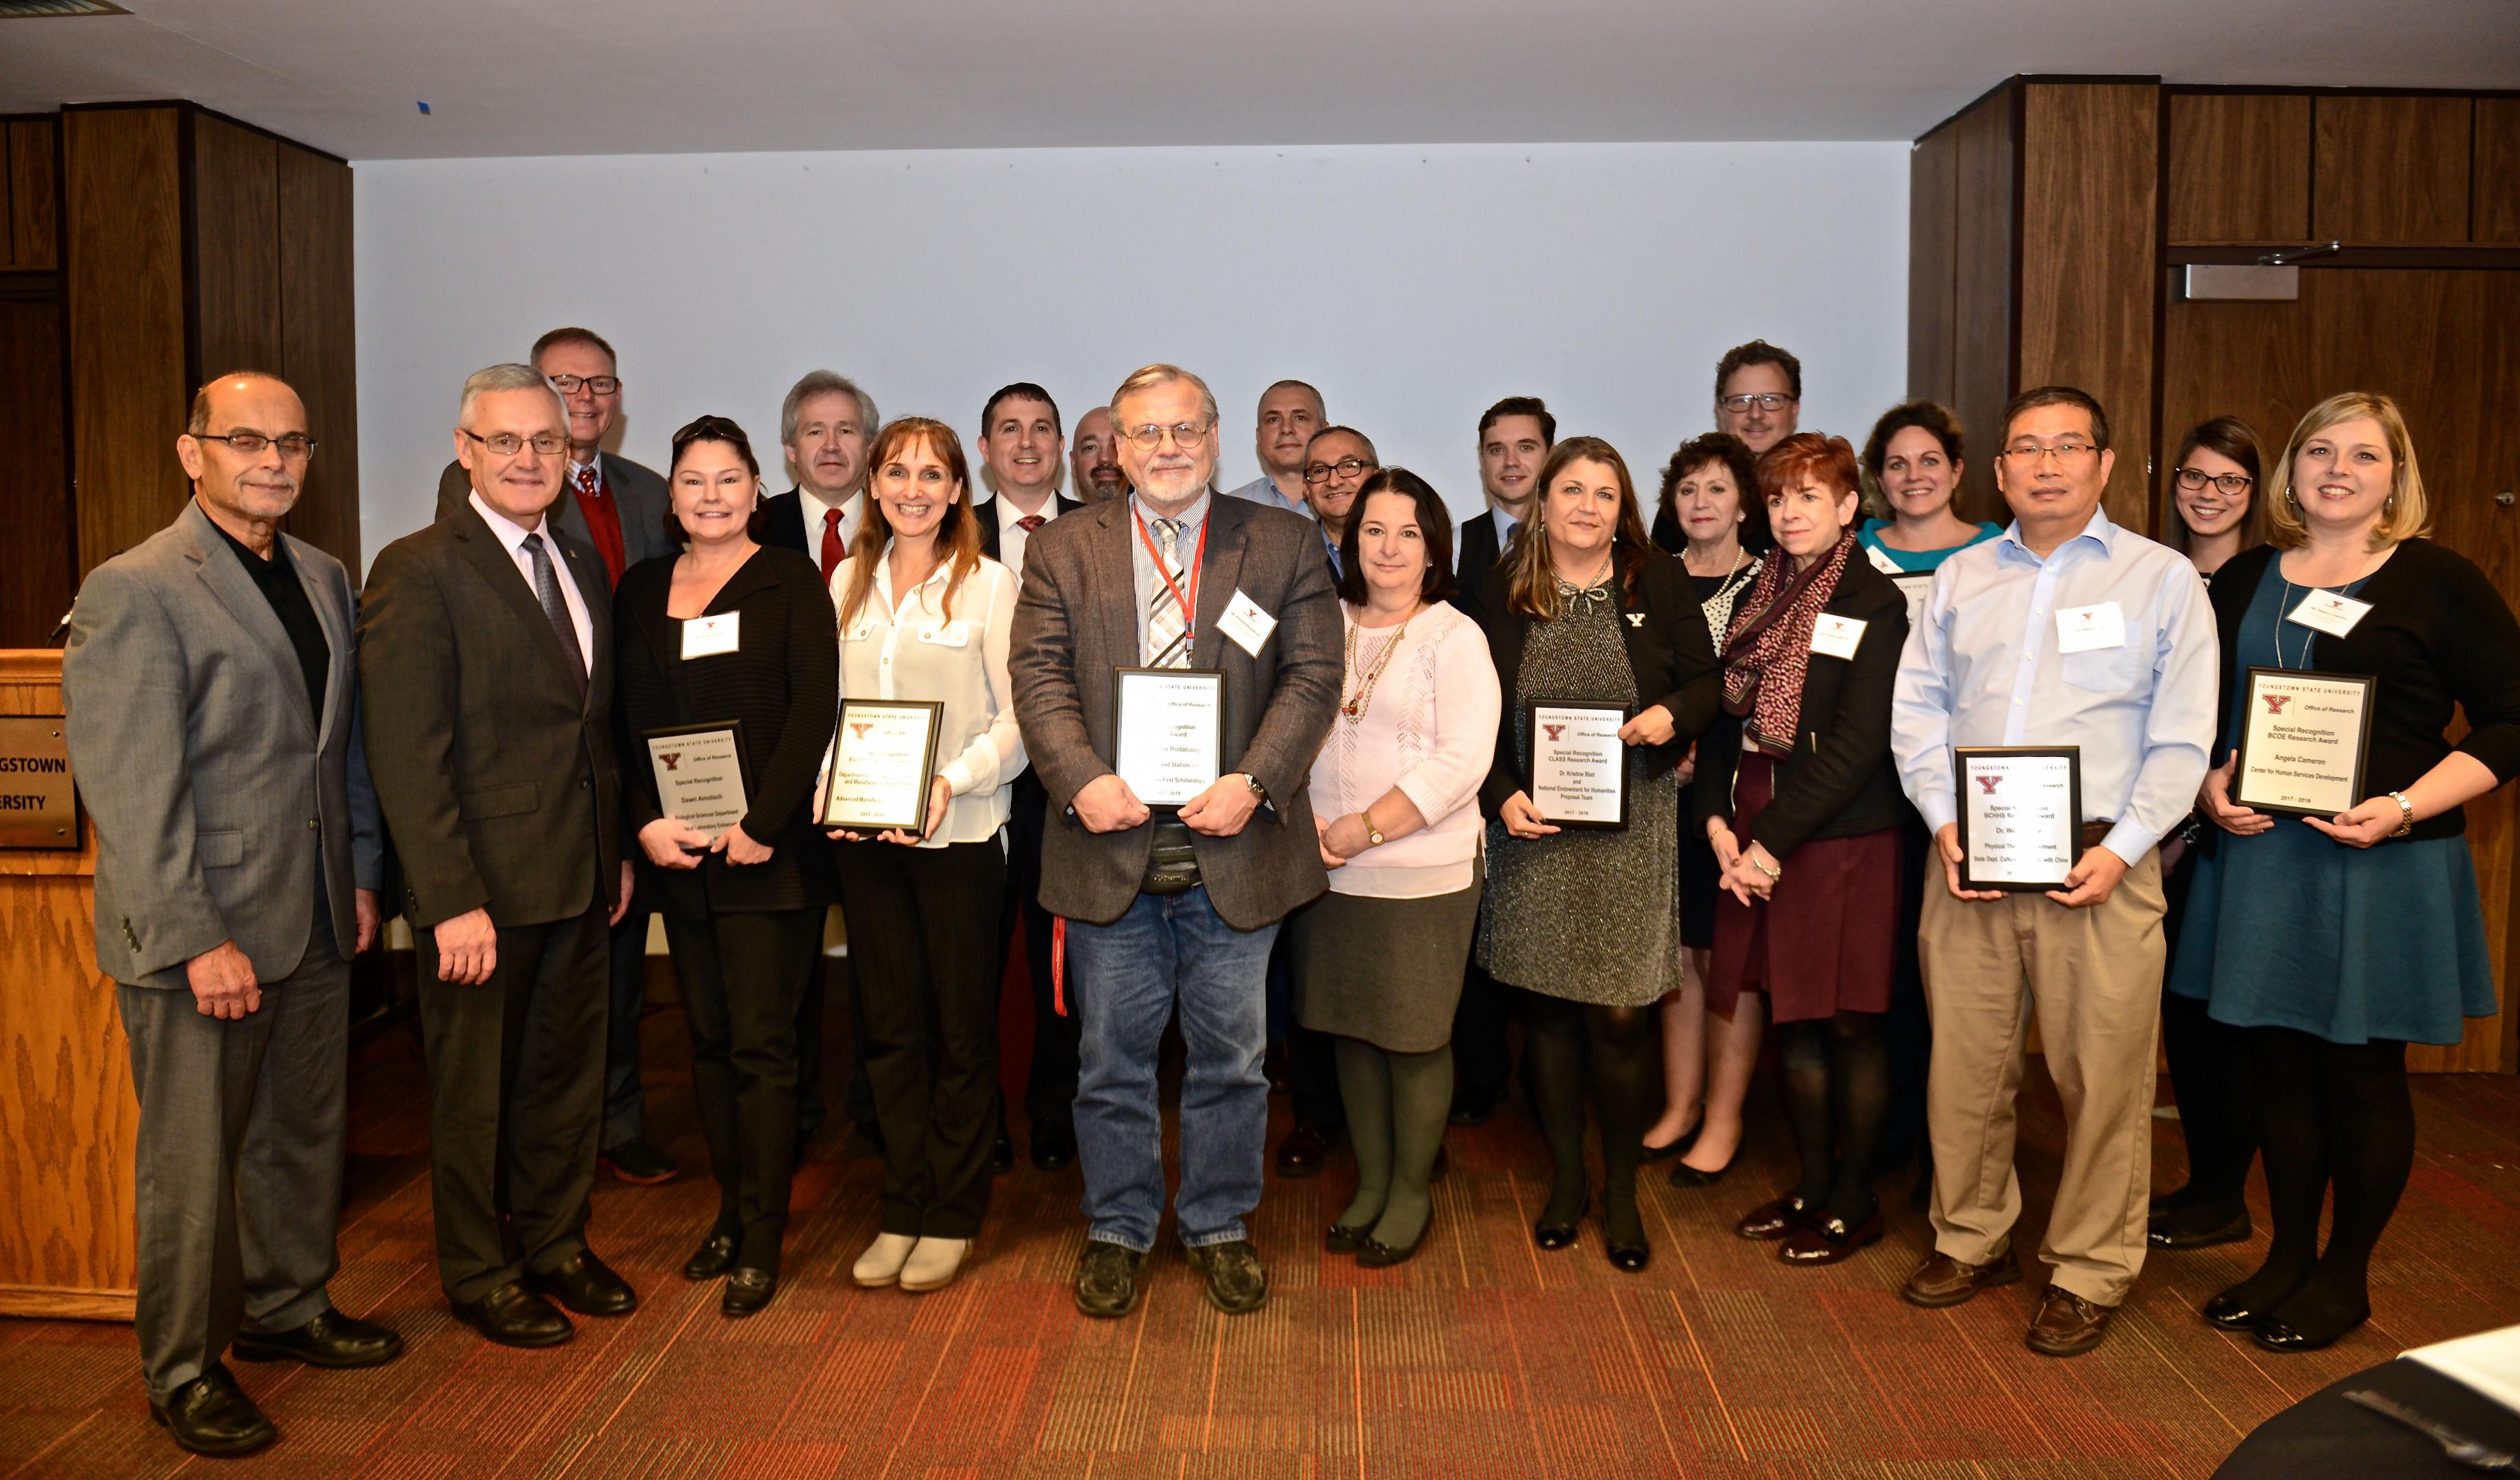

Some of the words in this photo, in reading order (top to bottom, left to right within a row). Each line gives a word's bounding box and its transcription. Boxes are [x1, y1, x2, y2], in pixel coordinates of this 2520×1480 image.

[2259, 683, 2299, 691] YOUNGSTOWN
[2273, 725, 2296, 734] Special
[2297, 727, 2335, 737] Recognition
[2288, 735, 2316, 743] Research
[2318, 737, 2338, 745] Award
[2275, 754, 2296, 763] Angela
[2298, 756, 2326, 765] Cameron
[694, 776, 723, 785] Recognition
[2294, 771, 2314, 780] Services
[2315, 773, 2349, 782] Development
[0, 795, 46, 810] RSITY
